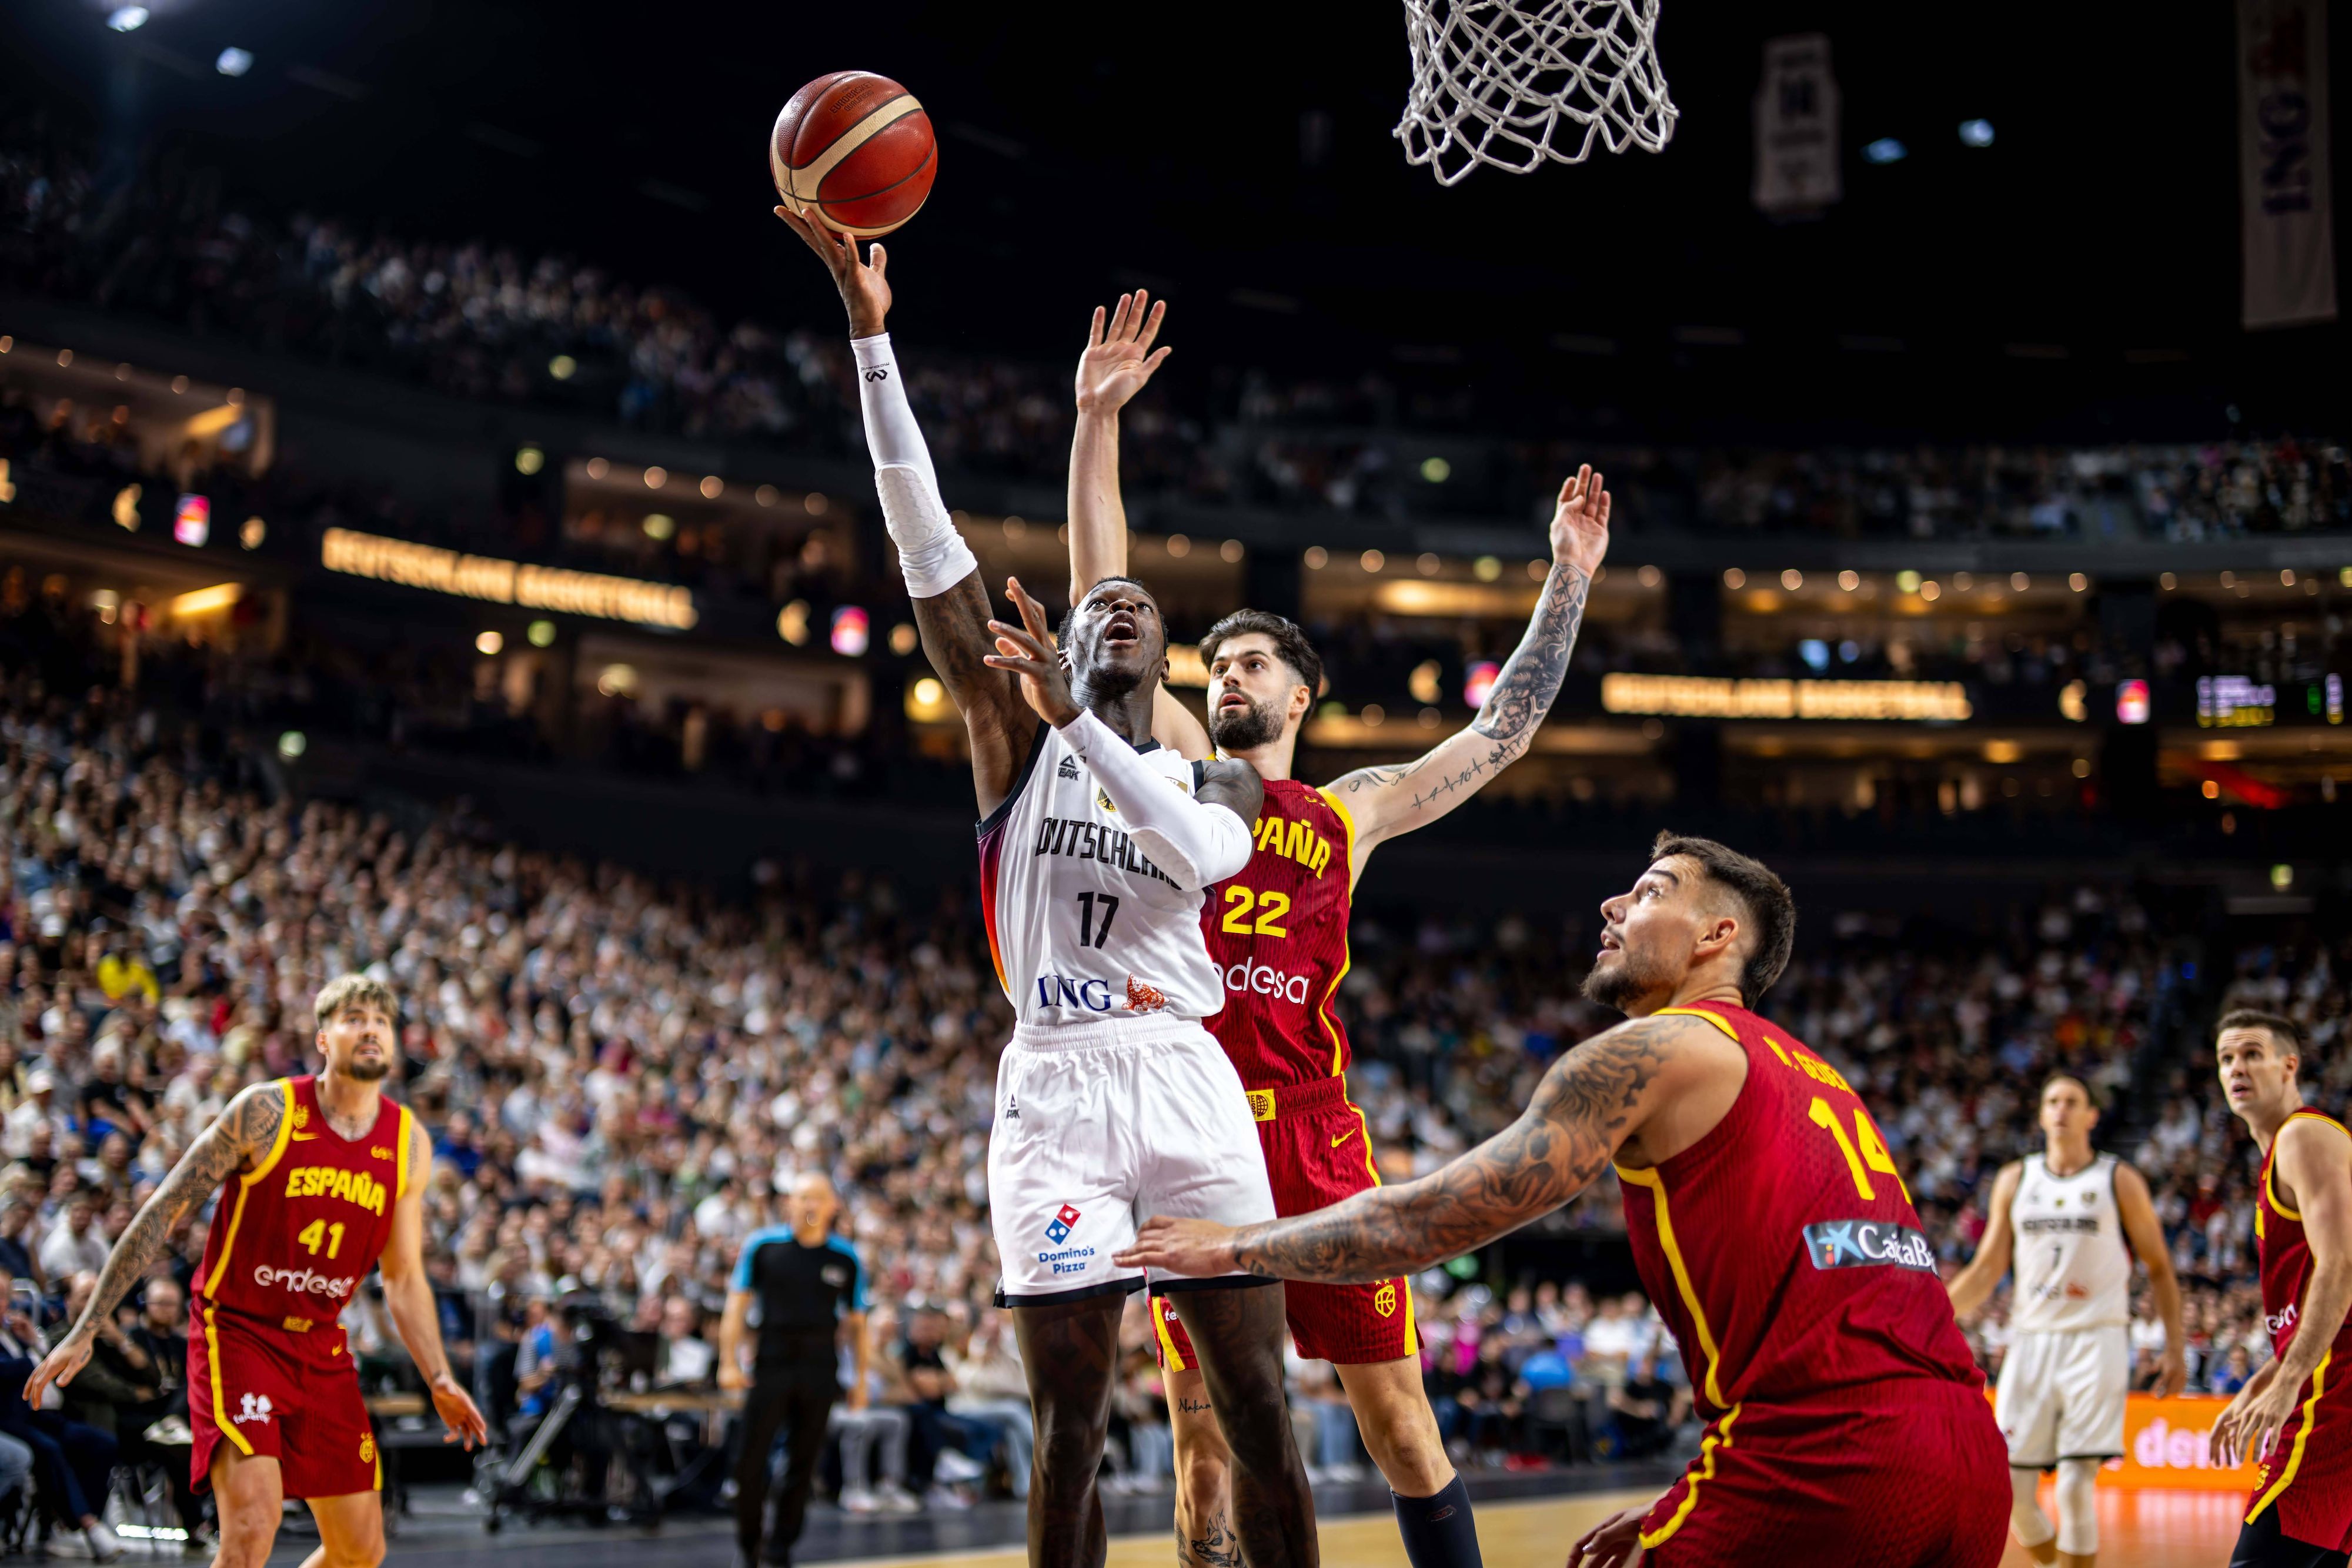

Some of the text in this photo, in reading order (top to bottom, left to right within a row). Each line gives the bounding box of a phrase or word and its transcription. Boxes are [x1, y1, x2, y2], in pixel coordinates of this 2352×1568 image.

[830, 82, 874, 113] EUROBASKET
[1077, 891, 1120, 950] 17
[1222, 885, 1291, 938] 22
[1037, 975, 1112, 1012] ING
[1808, 1096, 1912, 1206] 14
[285, 1165, 387, 1217] ESPAÑA
[298, 1218, 346, 1259] 41
[1038, 1245, 1095, 1263] Domino's
[1053, 1262, 1086, 1275] Pizza
